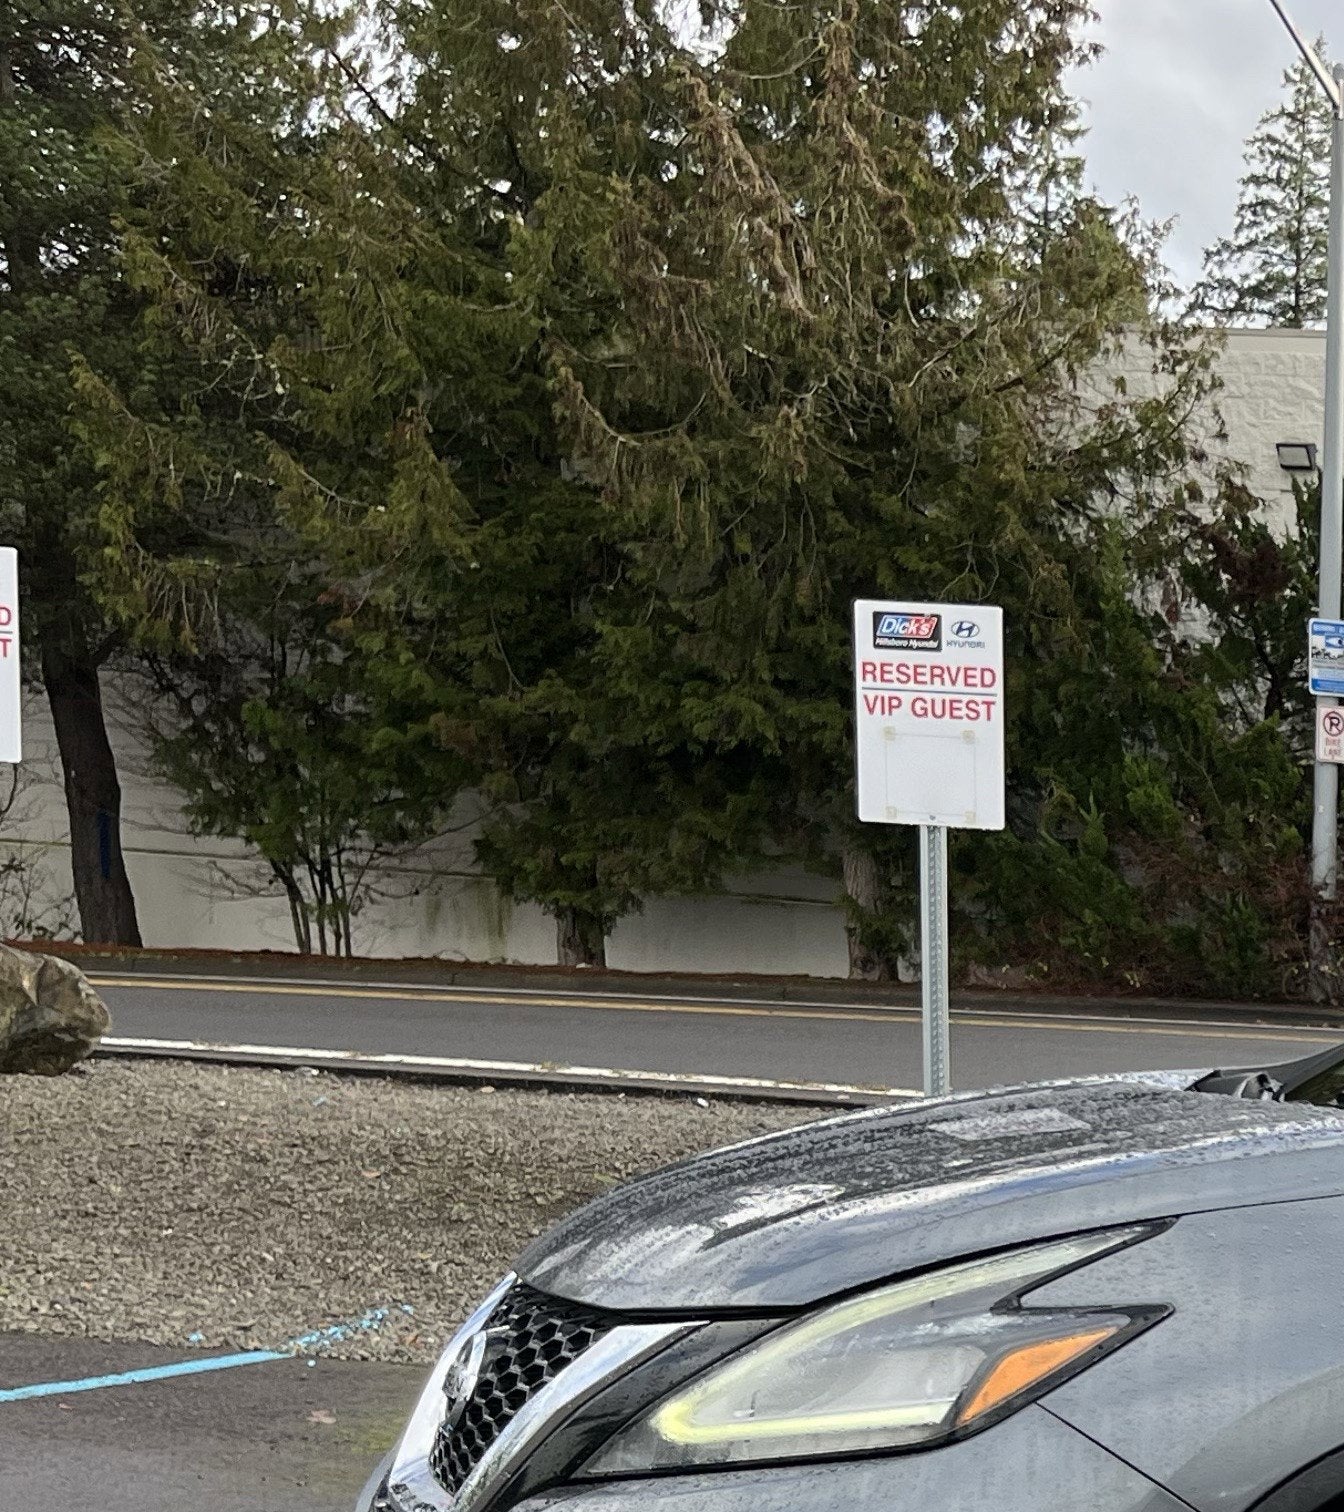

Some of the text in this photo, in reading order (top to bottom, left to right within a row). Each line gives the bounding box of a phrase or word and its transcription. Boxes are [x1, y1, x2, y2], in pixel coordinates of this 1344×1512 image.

[861, 661, 997, 688] RESERVED
[863, 694, 997, 722] VIP GUEST
